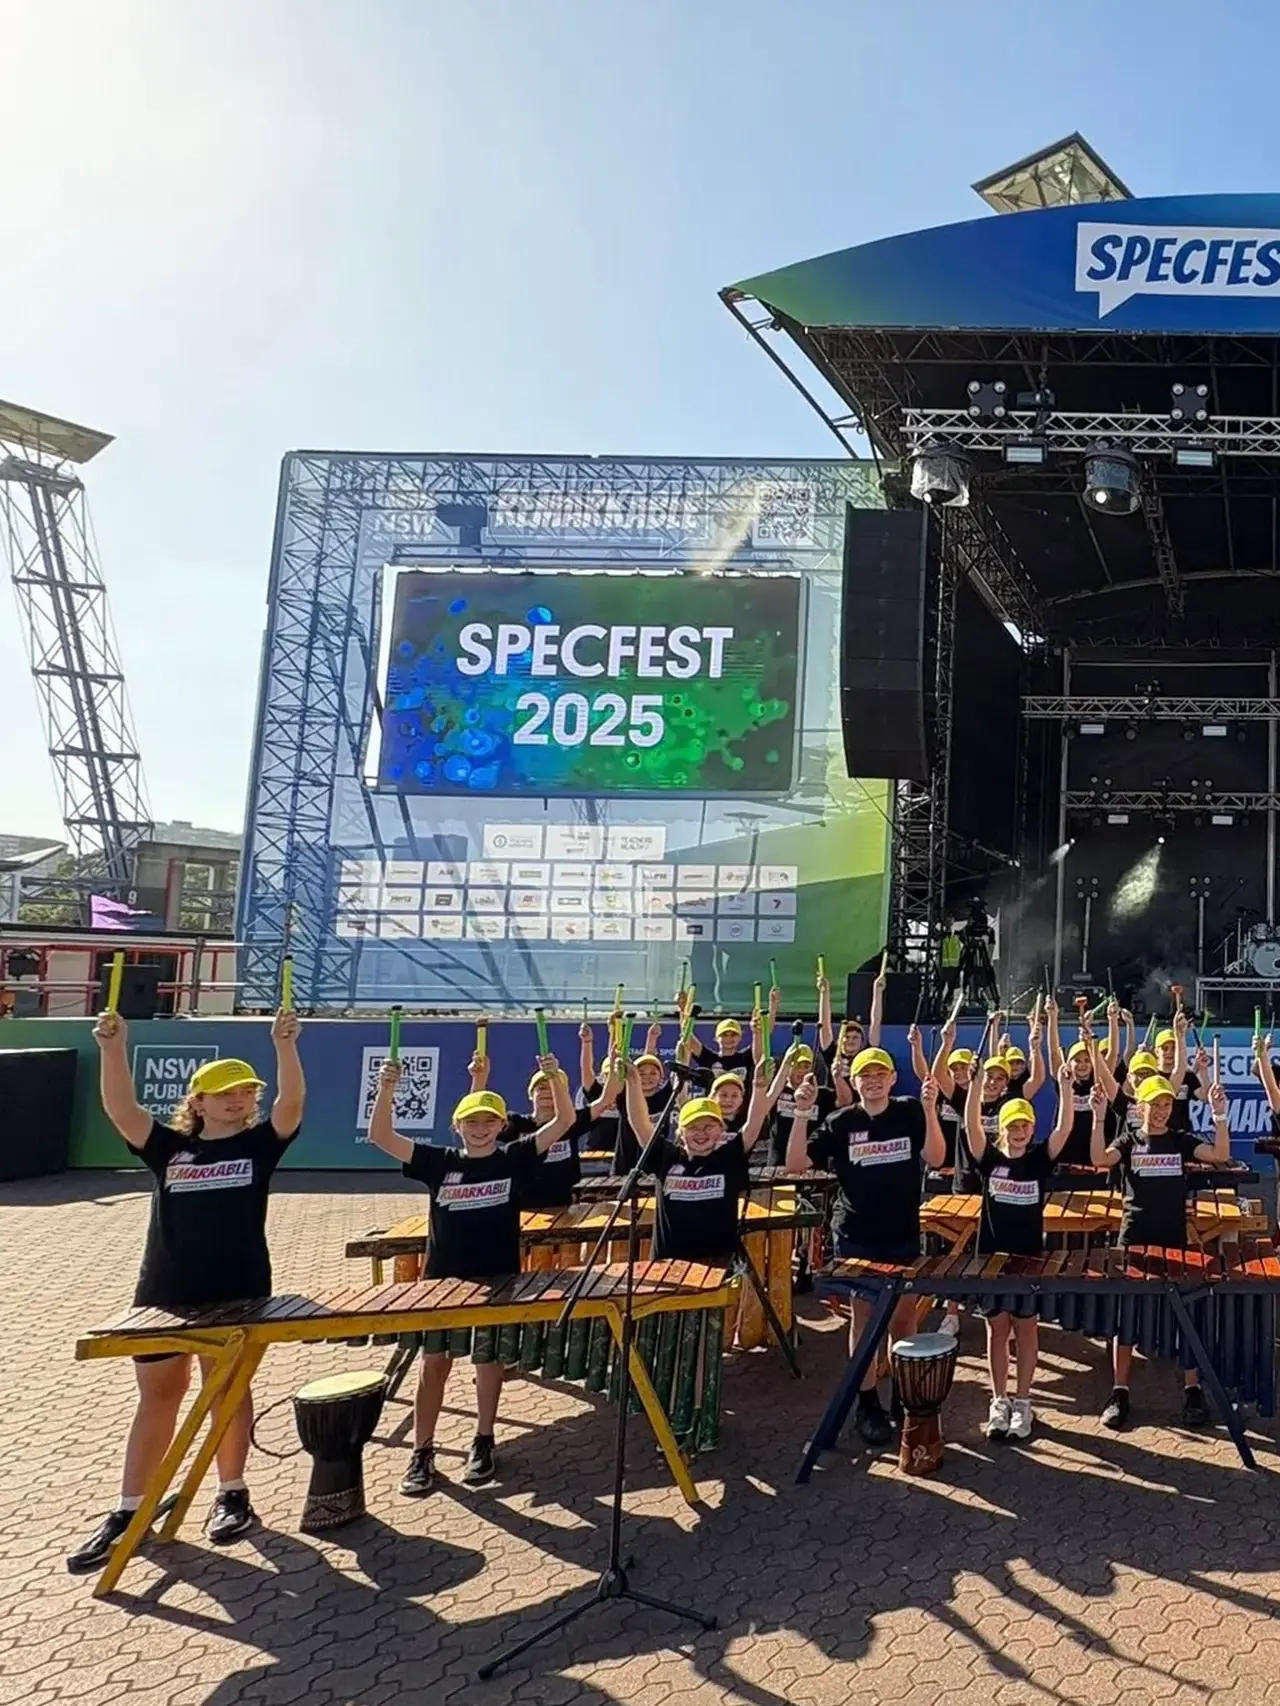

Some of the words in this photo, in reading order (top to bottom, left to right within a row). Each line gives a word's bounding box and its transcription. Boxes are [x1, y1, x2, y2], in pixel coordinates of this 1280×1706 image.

[455, 622, 735, 679] SPECFEST
[513, 693, 666, 746] 2025
[127, 890, 138, 905] 9
[145, 1058, 208, 1079] NSW
[143, 1083, 187, 1100] PUBL
[1188, 1098, 1273, 1133] REMAR
